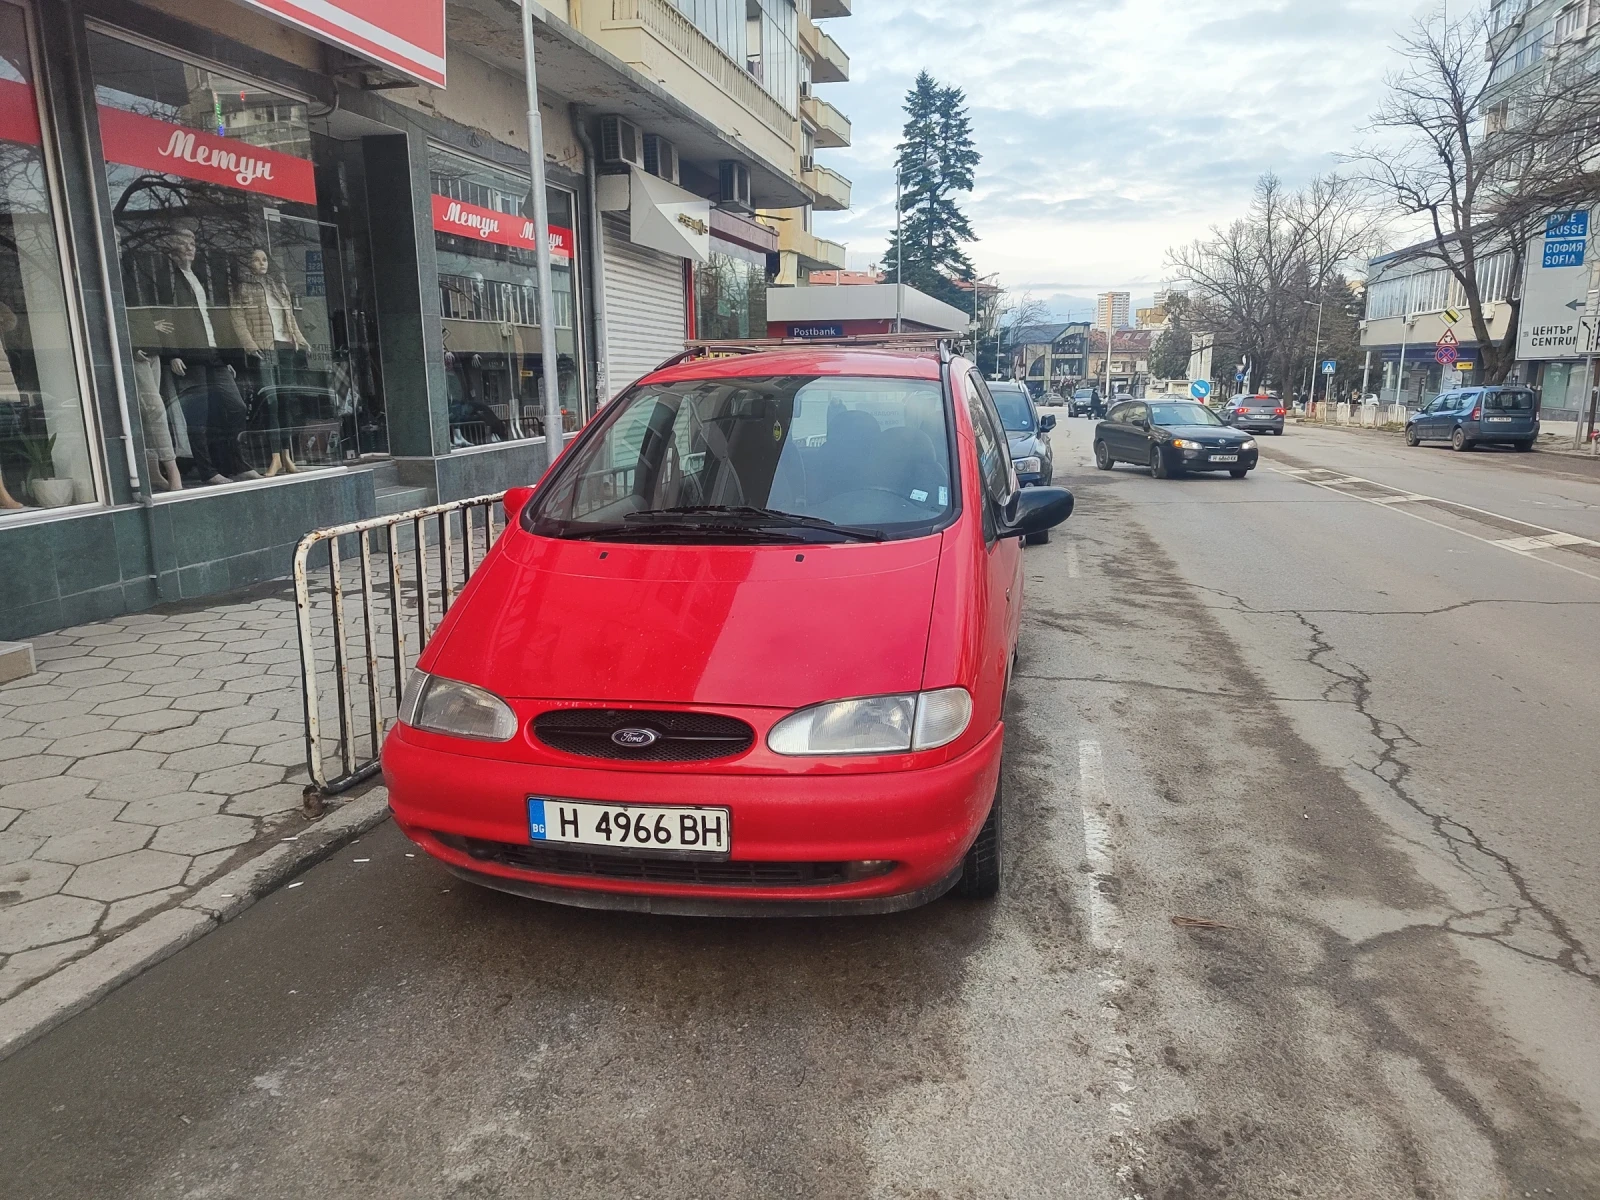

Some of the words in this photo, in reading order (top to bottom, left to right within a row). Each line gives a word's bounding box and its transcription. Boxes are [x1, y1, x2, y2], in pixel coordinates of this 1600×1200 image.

[157, 129, 275, 186] Метун
[442, 201, 500, 239] Метун
[518, 221, 564, 252] Мун
[1546, 242, 1584, 254] СОФИЯ
[1544, 254, 1576, 265] SOFIA
[793, 326, 836, 336] Postbank
[1532, 325, 1574, 337] ЦЕНТЪР
[620, 731, 645, 742] Ford
[532, 823, 545, 833] BG
[559, 807, 580, 839] H
[595, 810, 672, 845] 4966
[679, 814, 722, 847] BH
